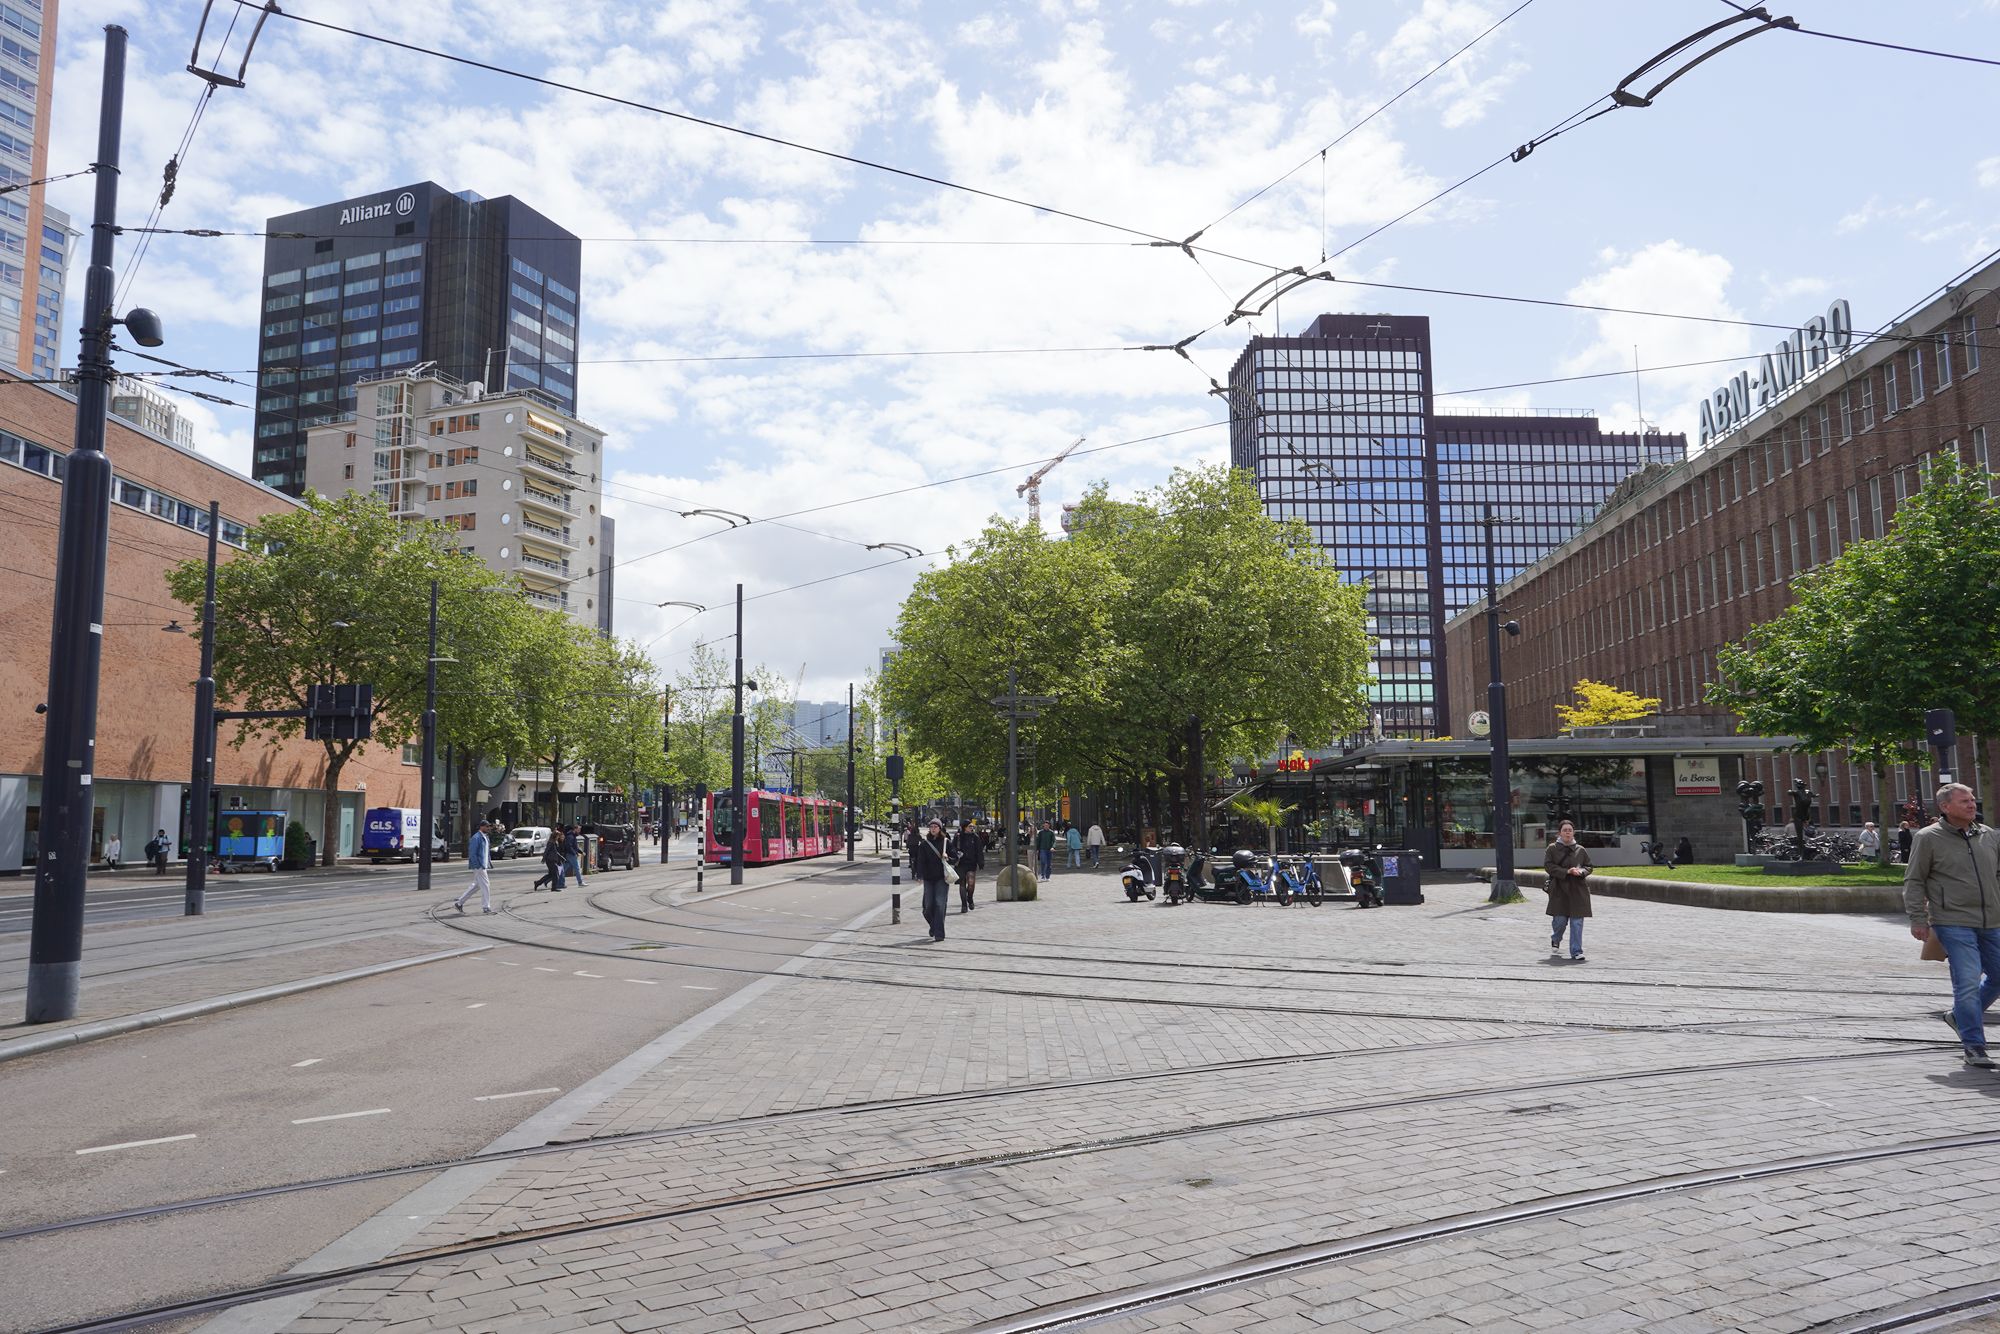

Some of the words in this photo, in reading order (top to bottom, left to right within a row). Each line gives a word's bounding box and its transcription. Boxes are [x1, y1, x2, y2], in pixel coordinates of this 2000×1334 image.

[340, 202, 391, 225] Allianz
[1679, 773, 1688, 782] la
[1690, 773, 1716, 782] Borsa
[406, 816, 418, 827] GLS
